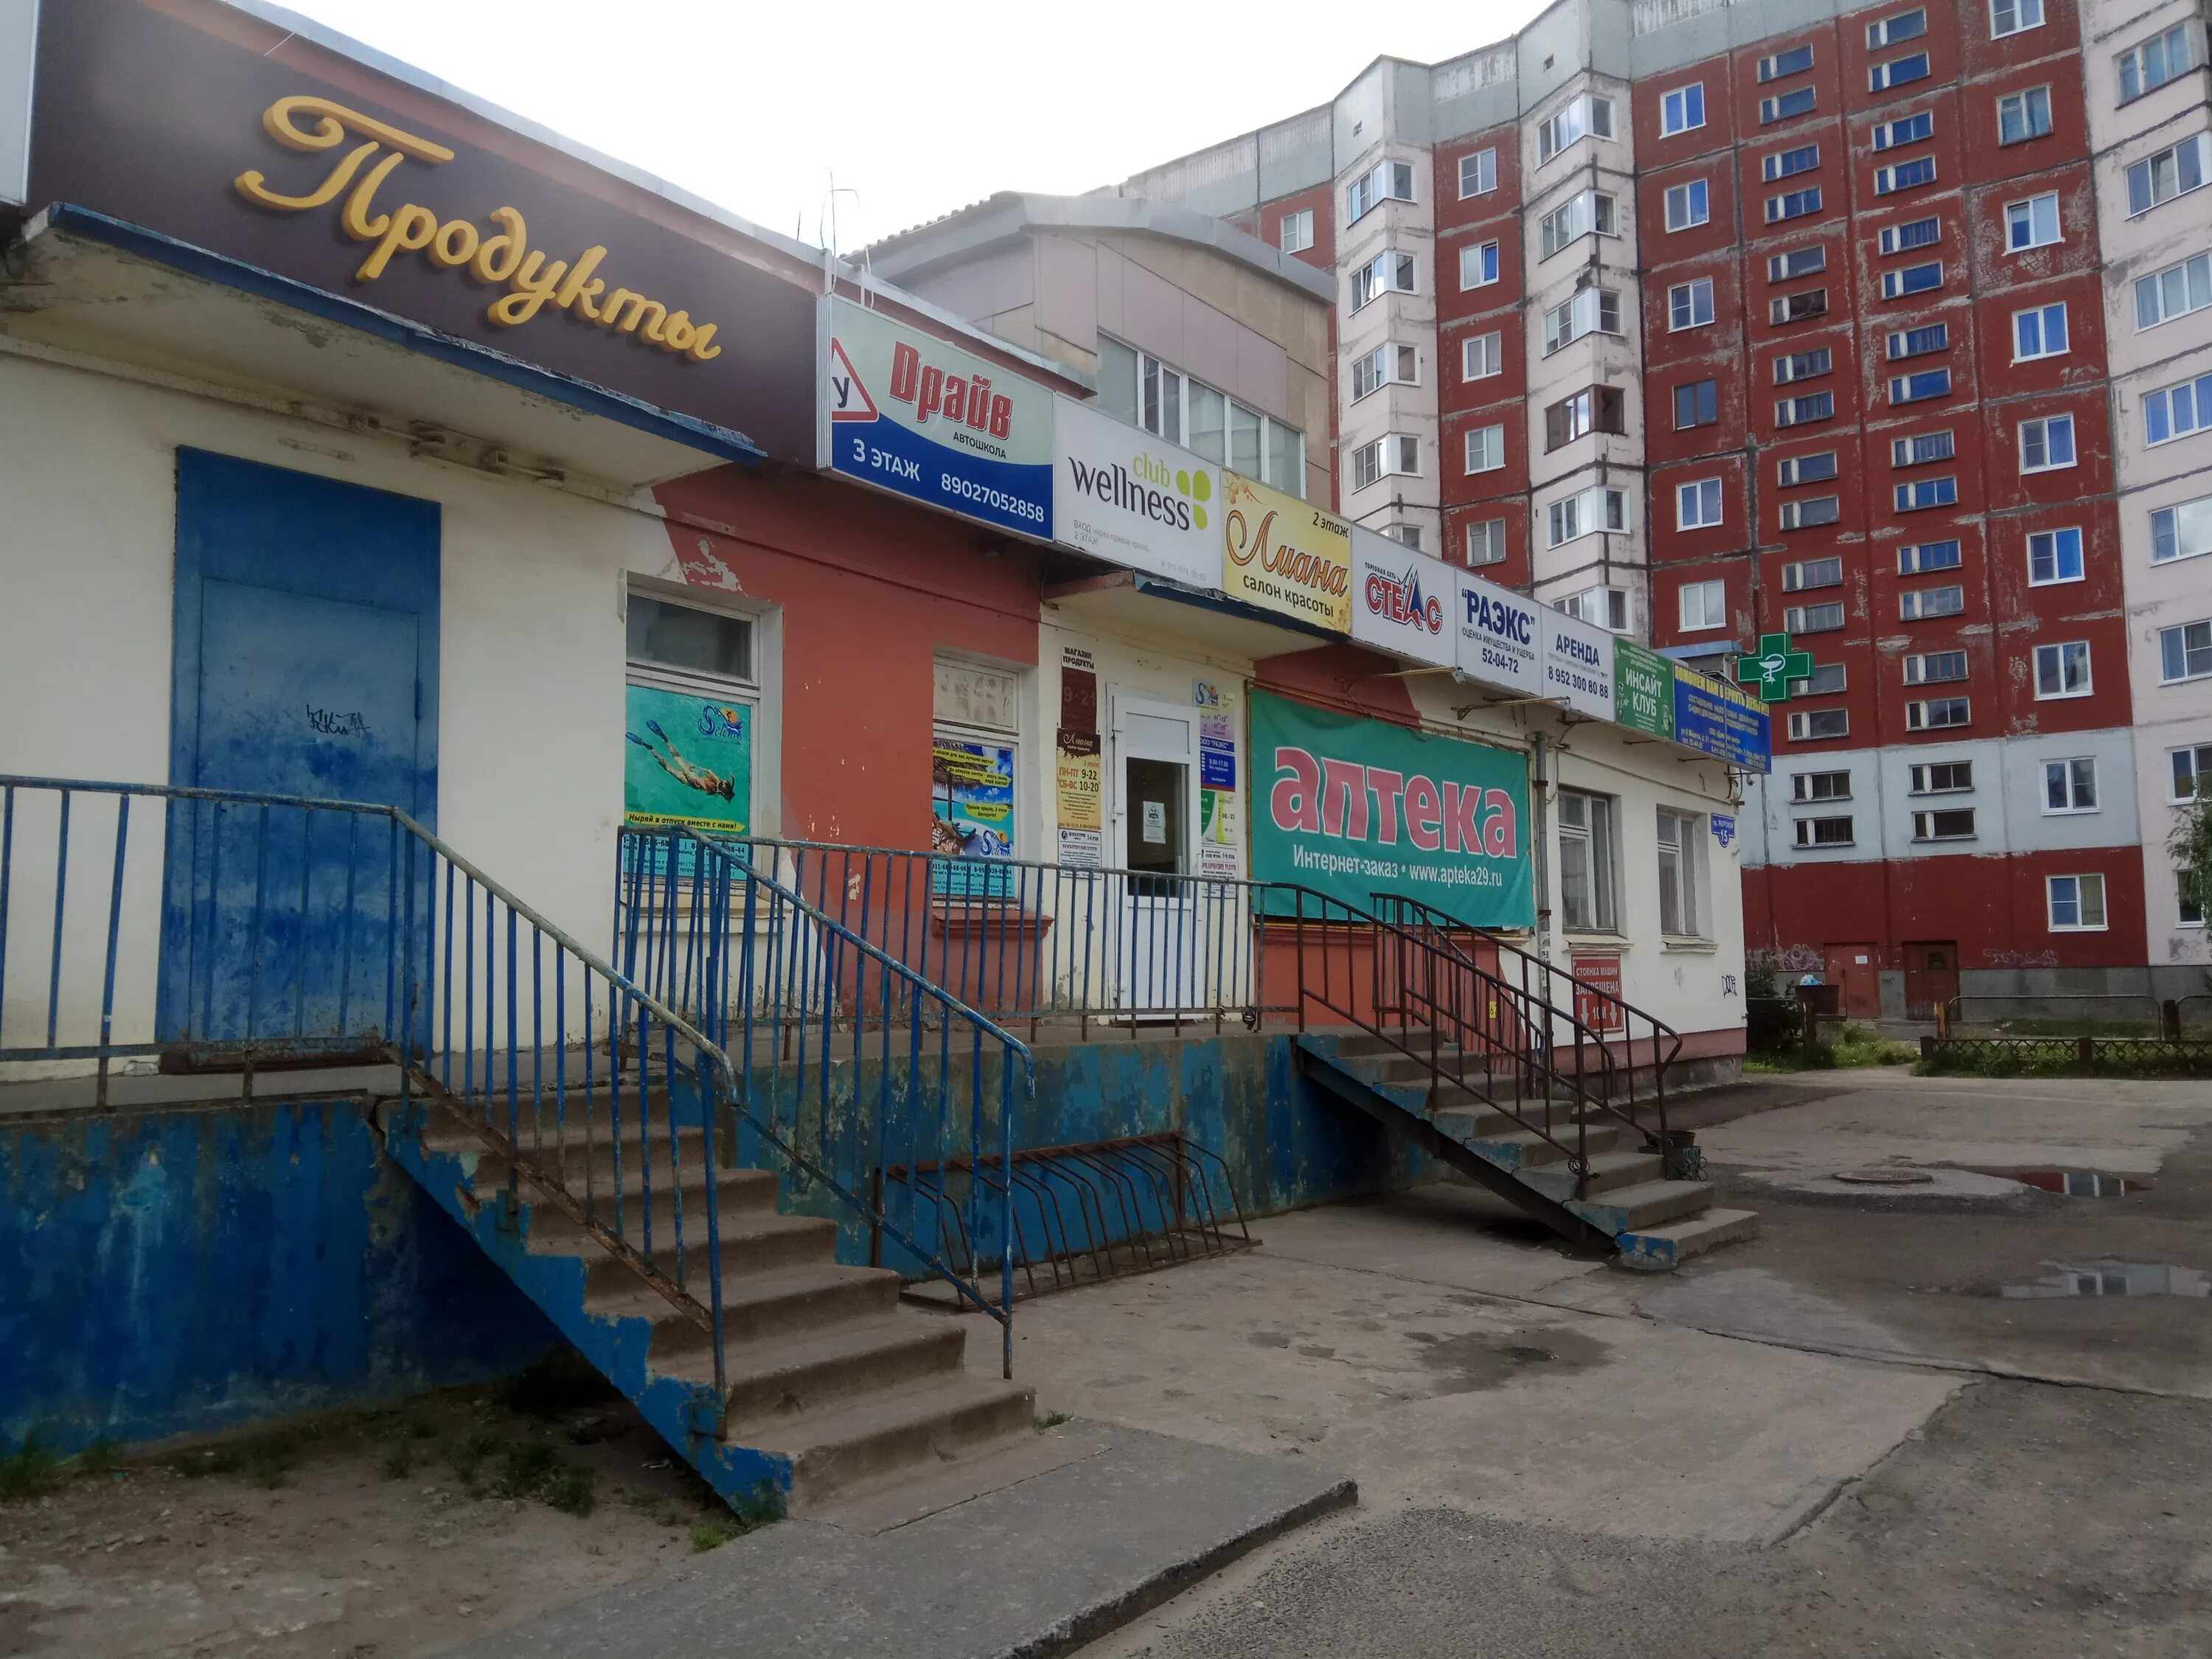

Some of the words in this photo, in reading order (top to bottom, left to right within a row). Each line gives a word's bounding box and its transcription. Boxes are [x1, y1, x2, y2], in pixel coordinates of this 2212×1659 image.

[234, 96, 722, 363] Продукты
[953, 431, 1006, 459] АВТОШКОЛА
[852, 439, 866, 463] 3
[871, 448, 921, 482] ЭТАЖ
[1133, 452, 1172, 488] club
[941, 473, 1045, 524] 89027052858
[1068, 456, 1190, 532] wellness
[1074, 519, 1092, 534] ВХОД
[1312, 512, 1319, 526] 2
[1320, 518, 1349, 538] этаж
[1074, 531, 1079, 540] 2
[1079, 532, 1098, 546] ЭТАЖ
[1226, 509, 1349, 598] Лиана
[1365, 562, 1385, 575] ТОРГОВАЯ
[1386, 571, 1396, 579] СЕТЬ
[1243, 574, 1281, 599] салон
[1284, 588, 1335, 619] красоты
[1462, 627, 1483, 641] ОЦЕНКА
[1483, 633, 1512, 653] ИМУЩЕСТВА
[1556, 633, 1600, 667] АРЕНДА
[1062, 655, 1094, 669] ПРОДУКТЫ
[1064, 646, 1092, 661] МАГАЗИН
[1482, 647, 1519, 674] 52-04-72
[1548, 665, 1554, 680] 8
[1555, 668, 1571, 686] 952
[1572, 674, 1587, 692] 300
[1588, 679, 1598, 695] 80
[1599, 684, 1609, 699] 88
[1626, 667, 1663, 698] ИНСАЙТ
[1632, 691, 1657, 717] КЛУБ
[1063, 732, 1093, 748] Лиана
[1059, 767, 1079, 778] ПН-ПТ
[1082, 769, 1097, 780] 9-22
[1079, 781, 1099, 793] 10-20
[1270, 746, 1517, 859] аптека
[629, 814, 653, 823] Ныряй
[661, 818, 685, 827] отпуск
[1720, 829, 1728, 842] 15
[1293, 844, 1399, 878] Интернет-заказ
[1410, 864, 1503, 888] www.apteka29.ru
[1576, 967, 1599, 976] СТОЯНКА
[1601, 967, 1618, 975] МАШИН
